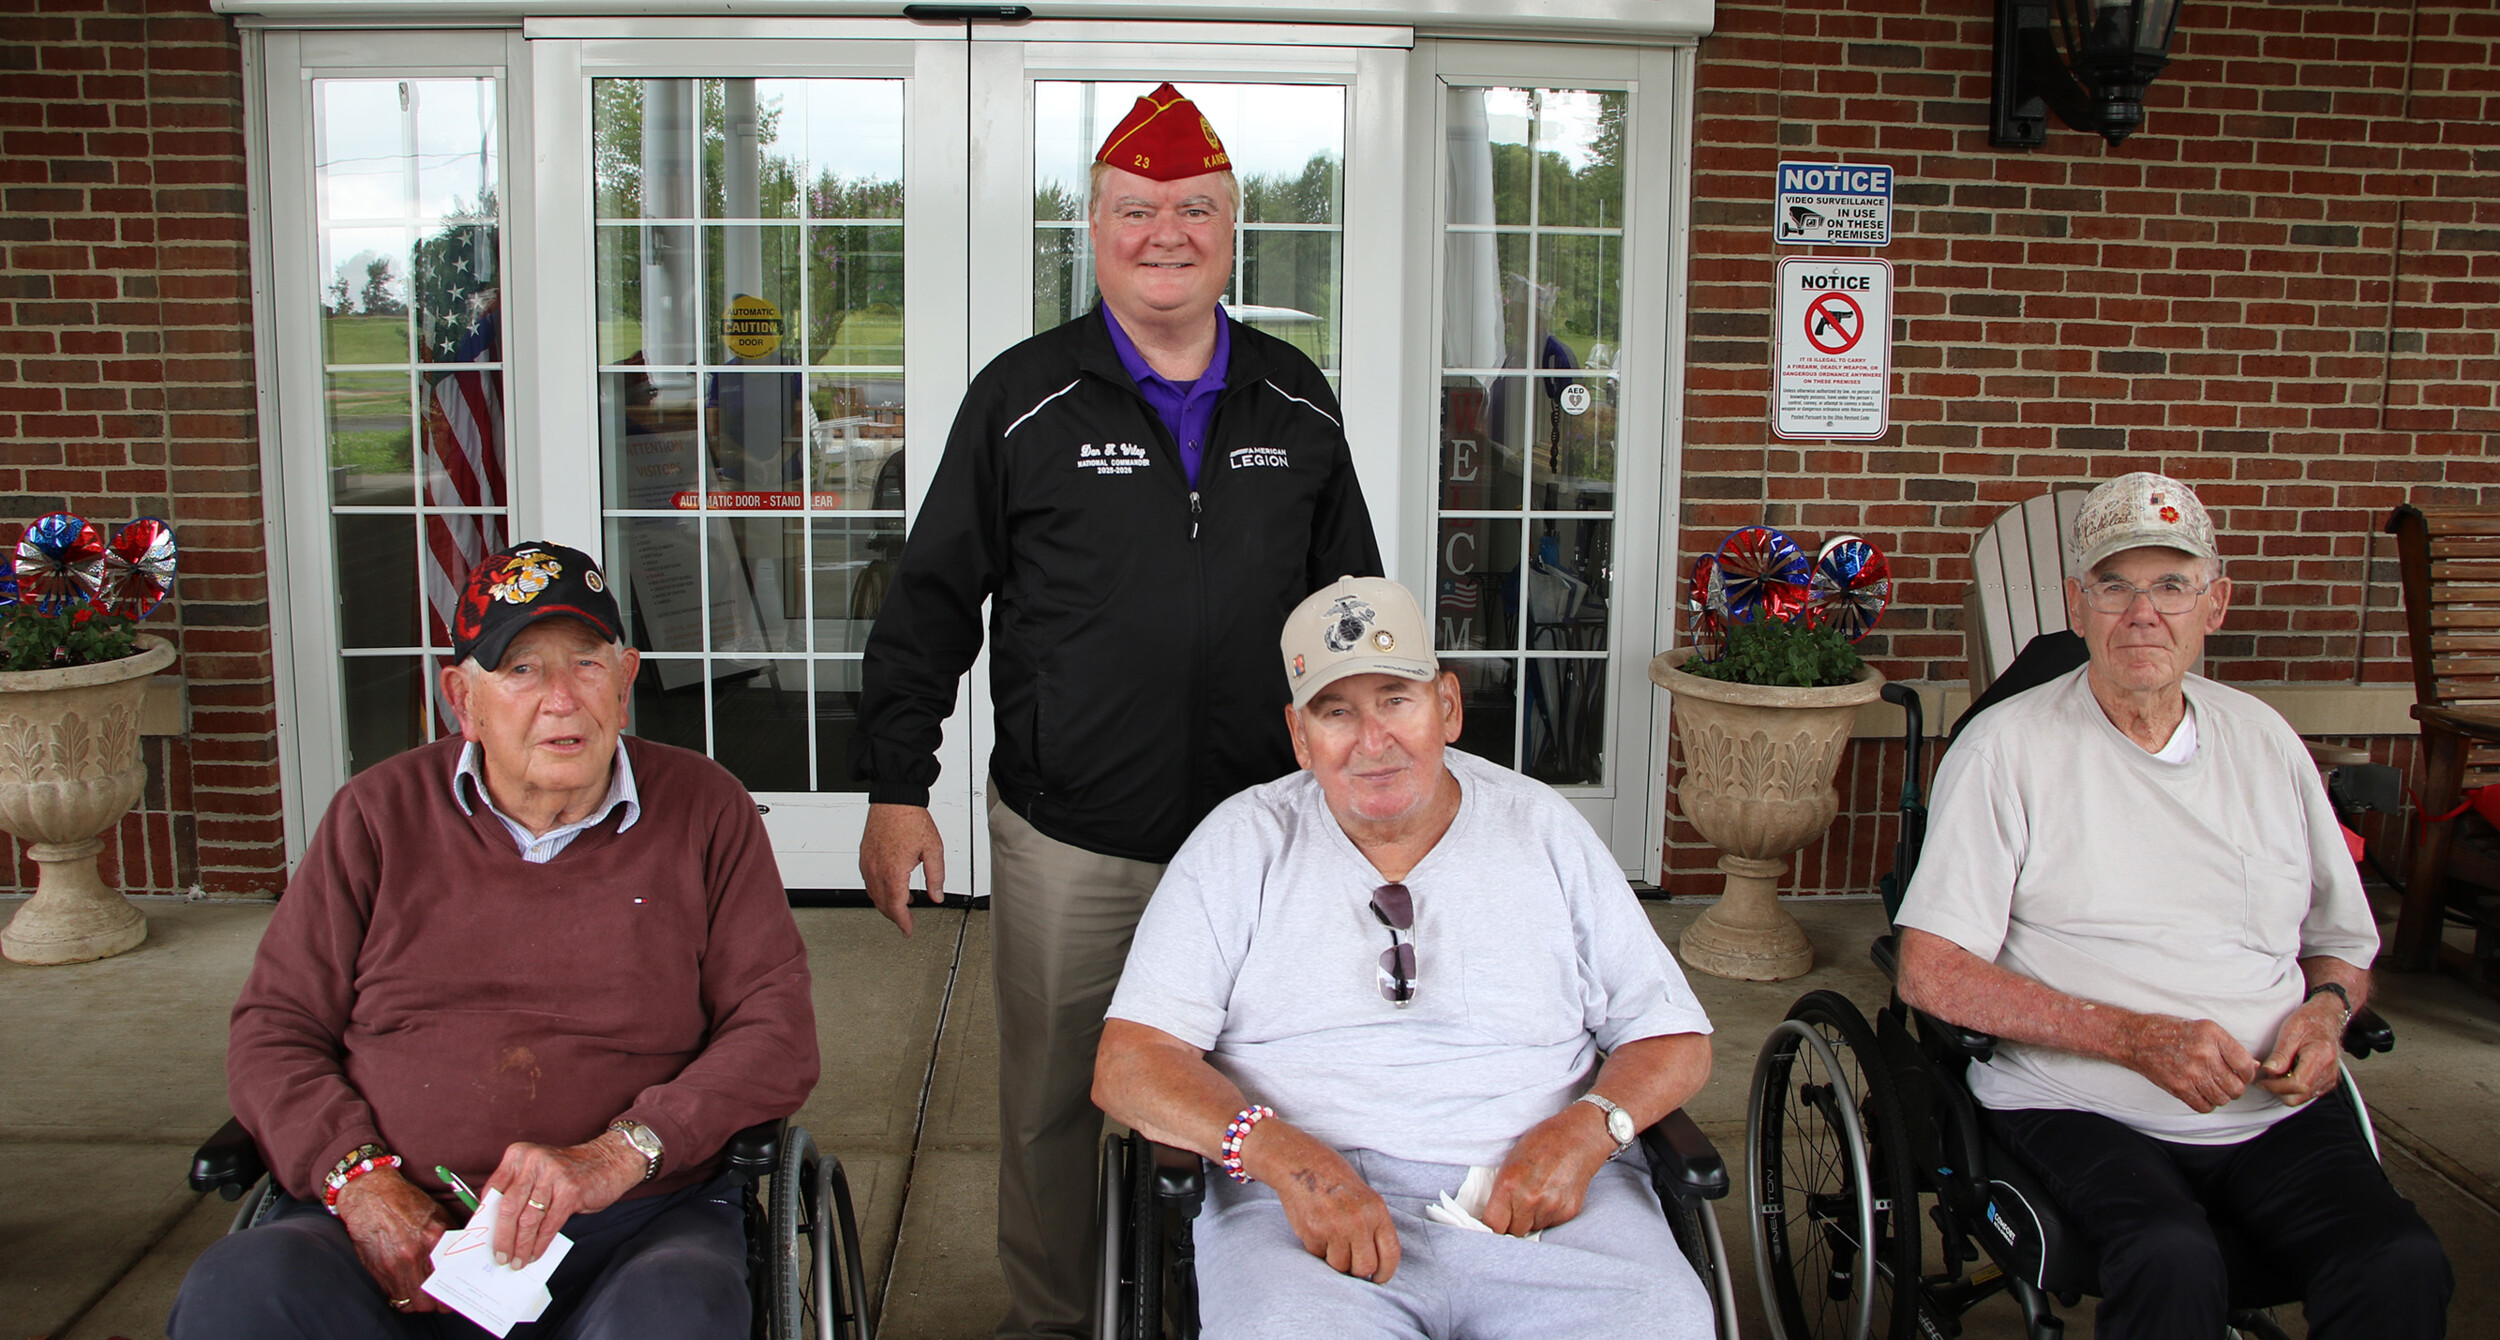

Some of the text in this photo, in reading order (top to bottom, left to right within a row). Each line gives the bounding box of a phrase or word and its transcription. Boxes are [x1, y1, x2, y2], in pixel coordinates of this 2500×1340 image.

[1134, 154, 1150, 169] 23
[1784, 169, 1886, 193] NOTICE
[1785, 196, 1885, 206] VIDEO SURVEILLANCE
[1838, 209, 1876, 218] IN USE
[1827, 219, 1884, 229] ON THESE
[1827, 230, 1884, 240] PREMISES
[1801, 275, 1870, 290] NOTICE
[728, 308, 775, 316] AUTOMATIC
[724, 321, 778, 333] CAUTION
[626, 440, 684, 456] ATTENTION
[1080, 443, 1101, 457] Dan
[1120, 442, 1146, 458] Wiley
[1248, 447, 1287, 456] AMERICAN
[1077, 458, 1150, 468] NATIONAL COMMANDER
[1230, 454, 1289, 470] LEGION
[636, 462, 683, 477] VISITORS
[679, 495, 733, 507] AUTMATIC
[735, 495, 761, 507] DOOR
[769, 495, 801, 507] STAND
